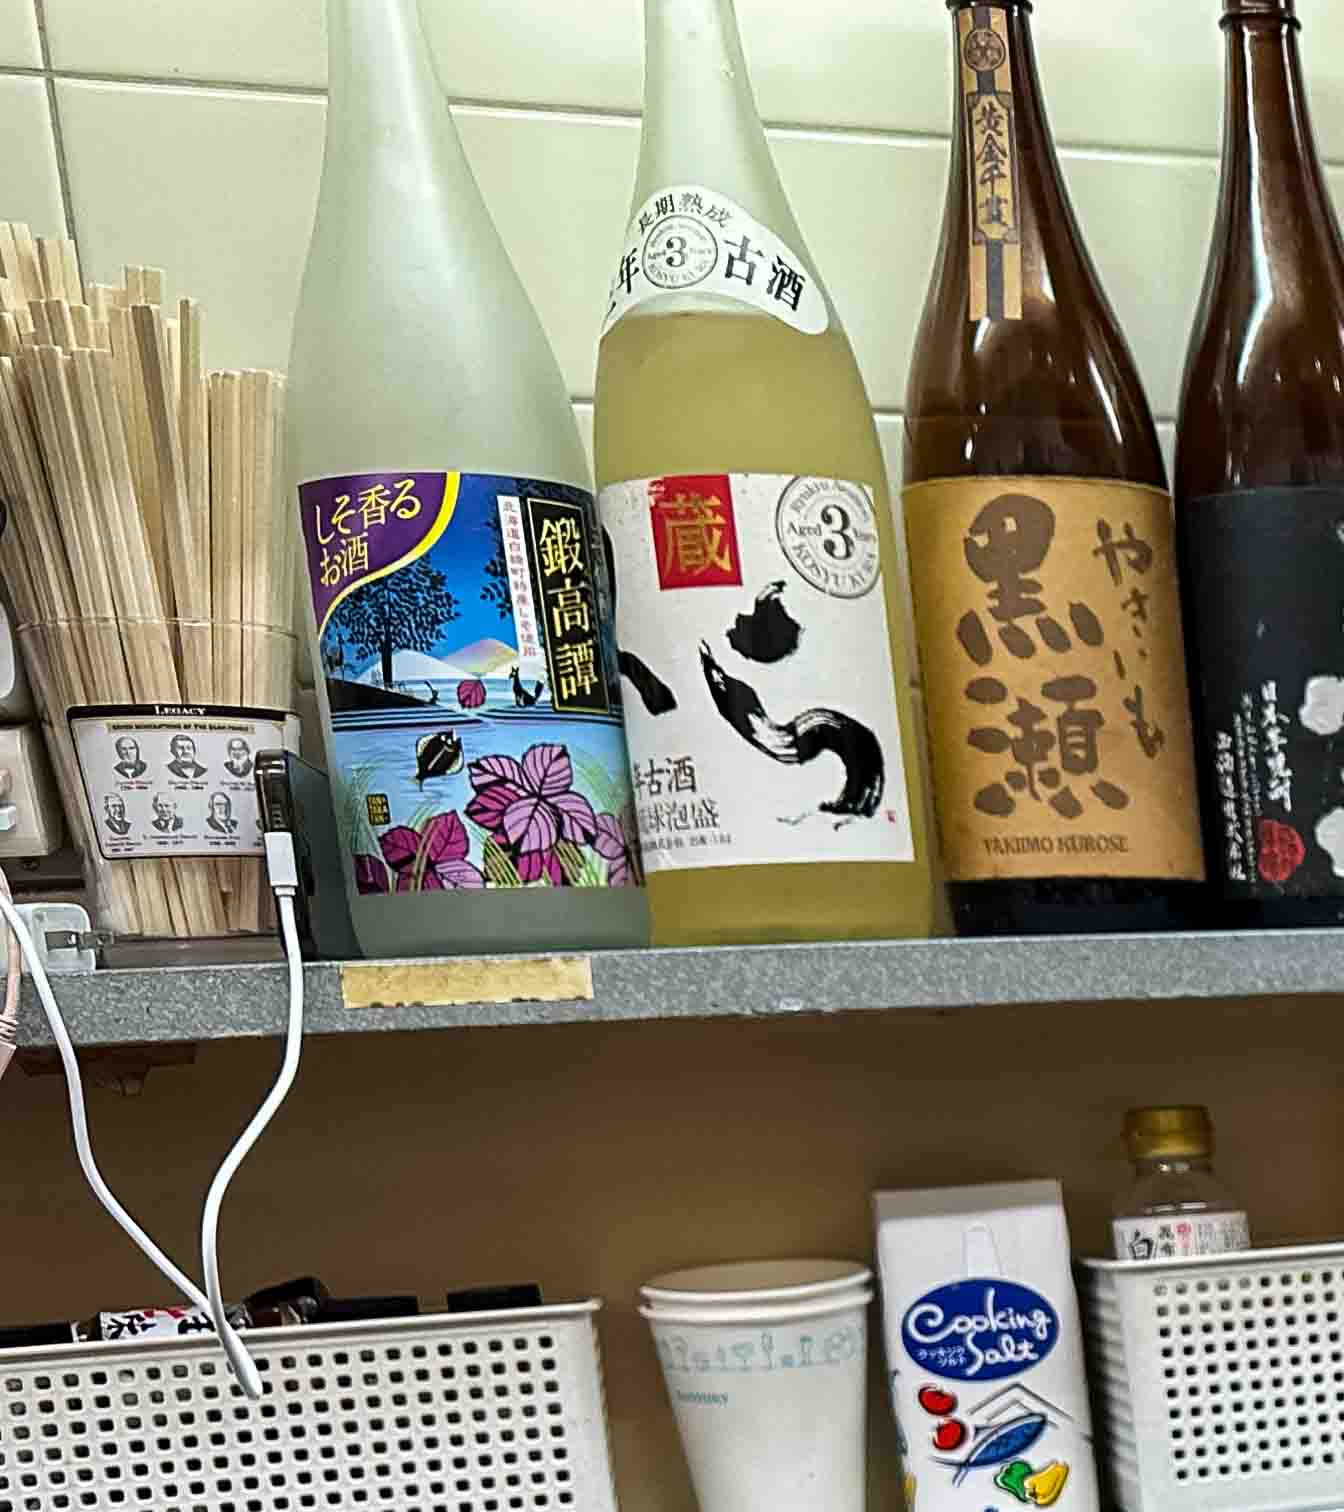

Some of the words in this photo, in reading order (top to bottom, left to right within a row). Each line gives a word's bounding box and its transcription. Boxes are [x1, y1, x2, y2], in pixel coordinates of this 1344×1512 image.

[665, 236, 689, 268] 3
[724, 234, 806, 311] 古酒
[315, 479, 422, 545] しそ香る
[820, 503, 856, 561] 3
[319, 532, 369, 587] お酒
[540, 516, 599, 700] 鍛高譚
[956, 493, 1130, 819] 黒瀬
[1092, 518, 1166, 758] やきいも
[154, 705, 207, 717] LEGACY
[907, 1287, 1051, 1344] Cooking
[964, 1332, 1040, 1377] Salt
